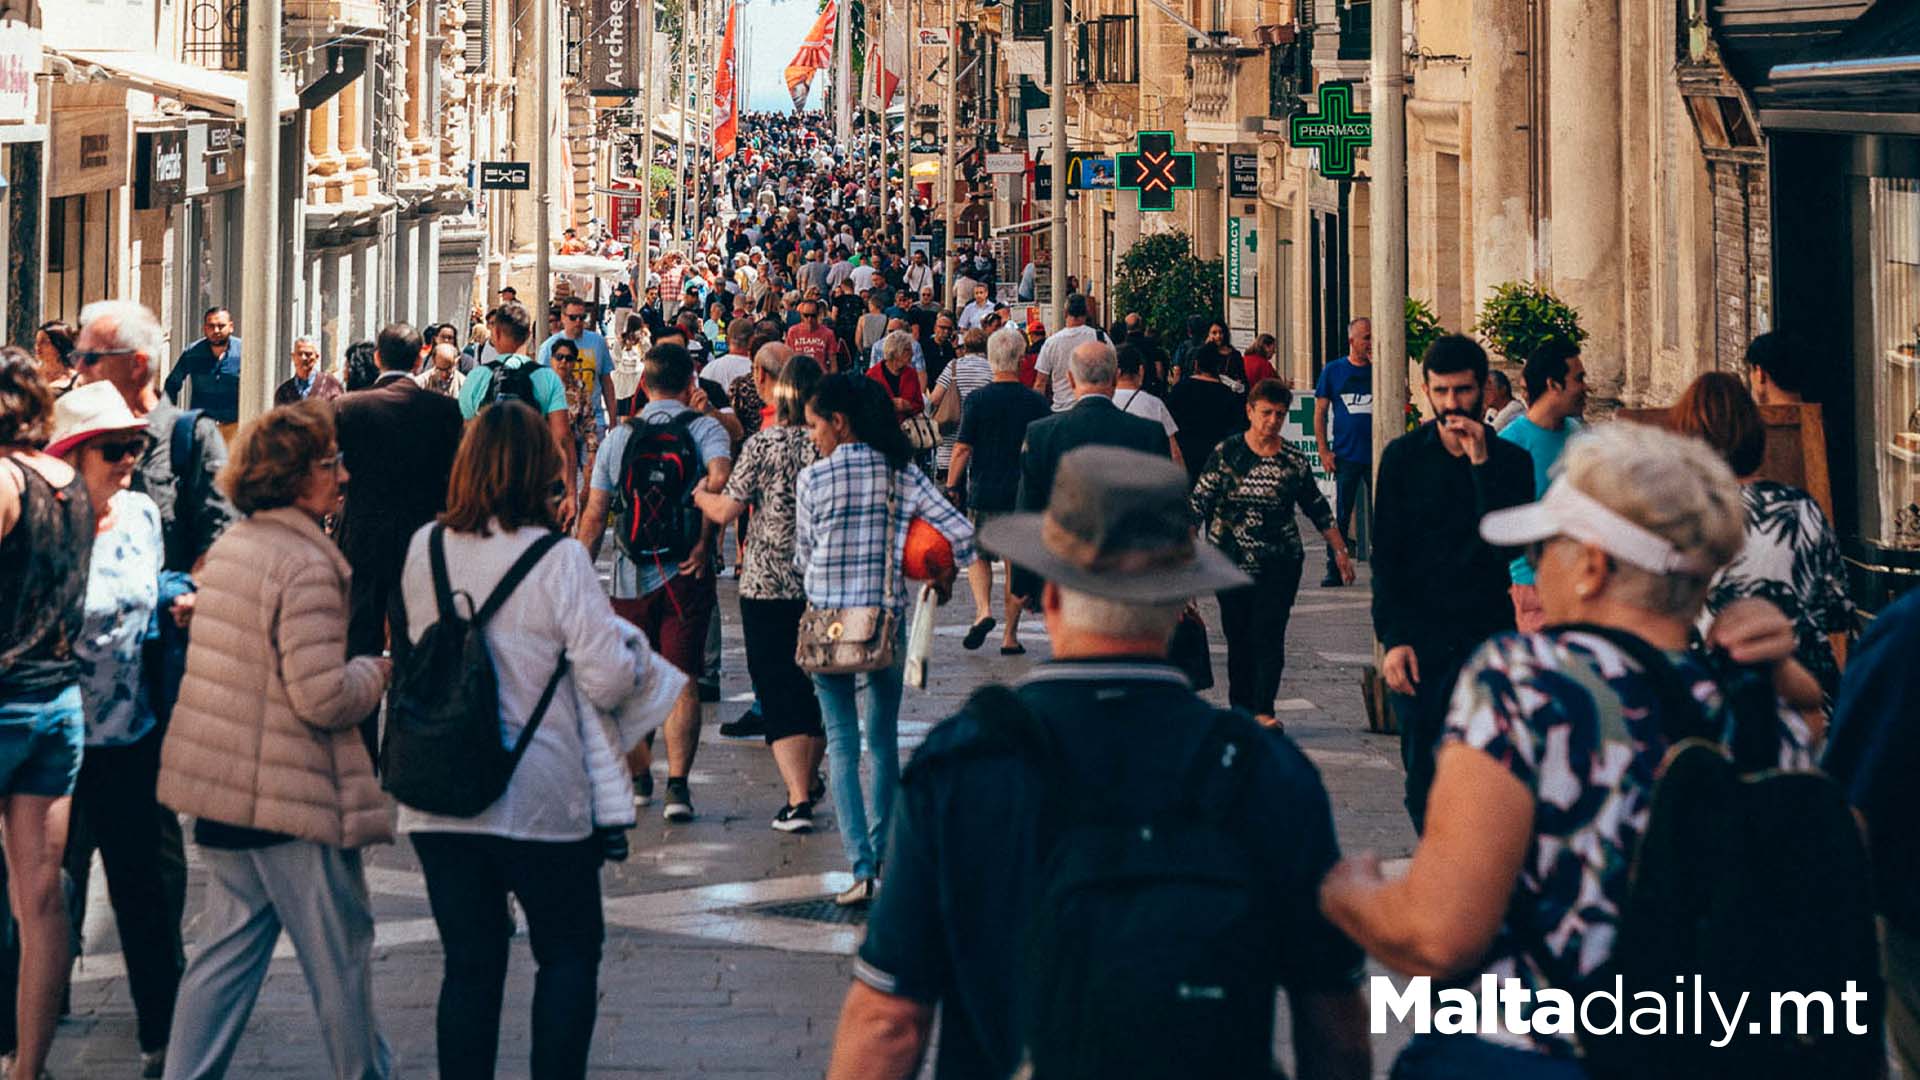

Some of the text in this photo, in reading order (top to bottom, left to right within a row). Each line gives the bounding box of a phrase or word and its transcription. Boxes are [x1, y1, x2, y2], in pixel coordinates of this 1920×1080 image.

[1300, 124, 1371, 136] PHARMACY
[1230, 220, 1239, 294] PHARMACY
[794, 337, 825, 352] ATLANTA
